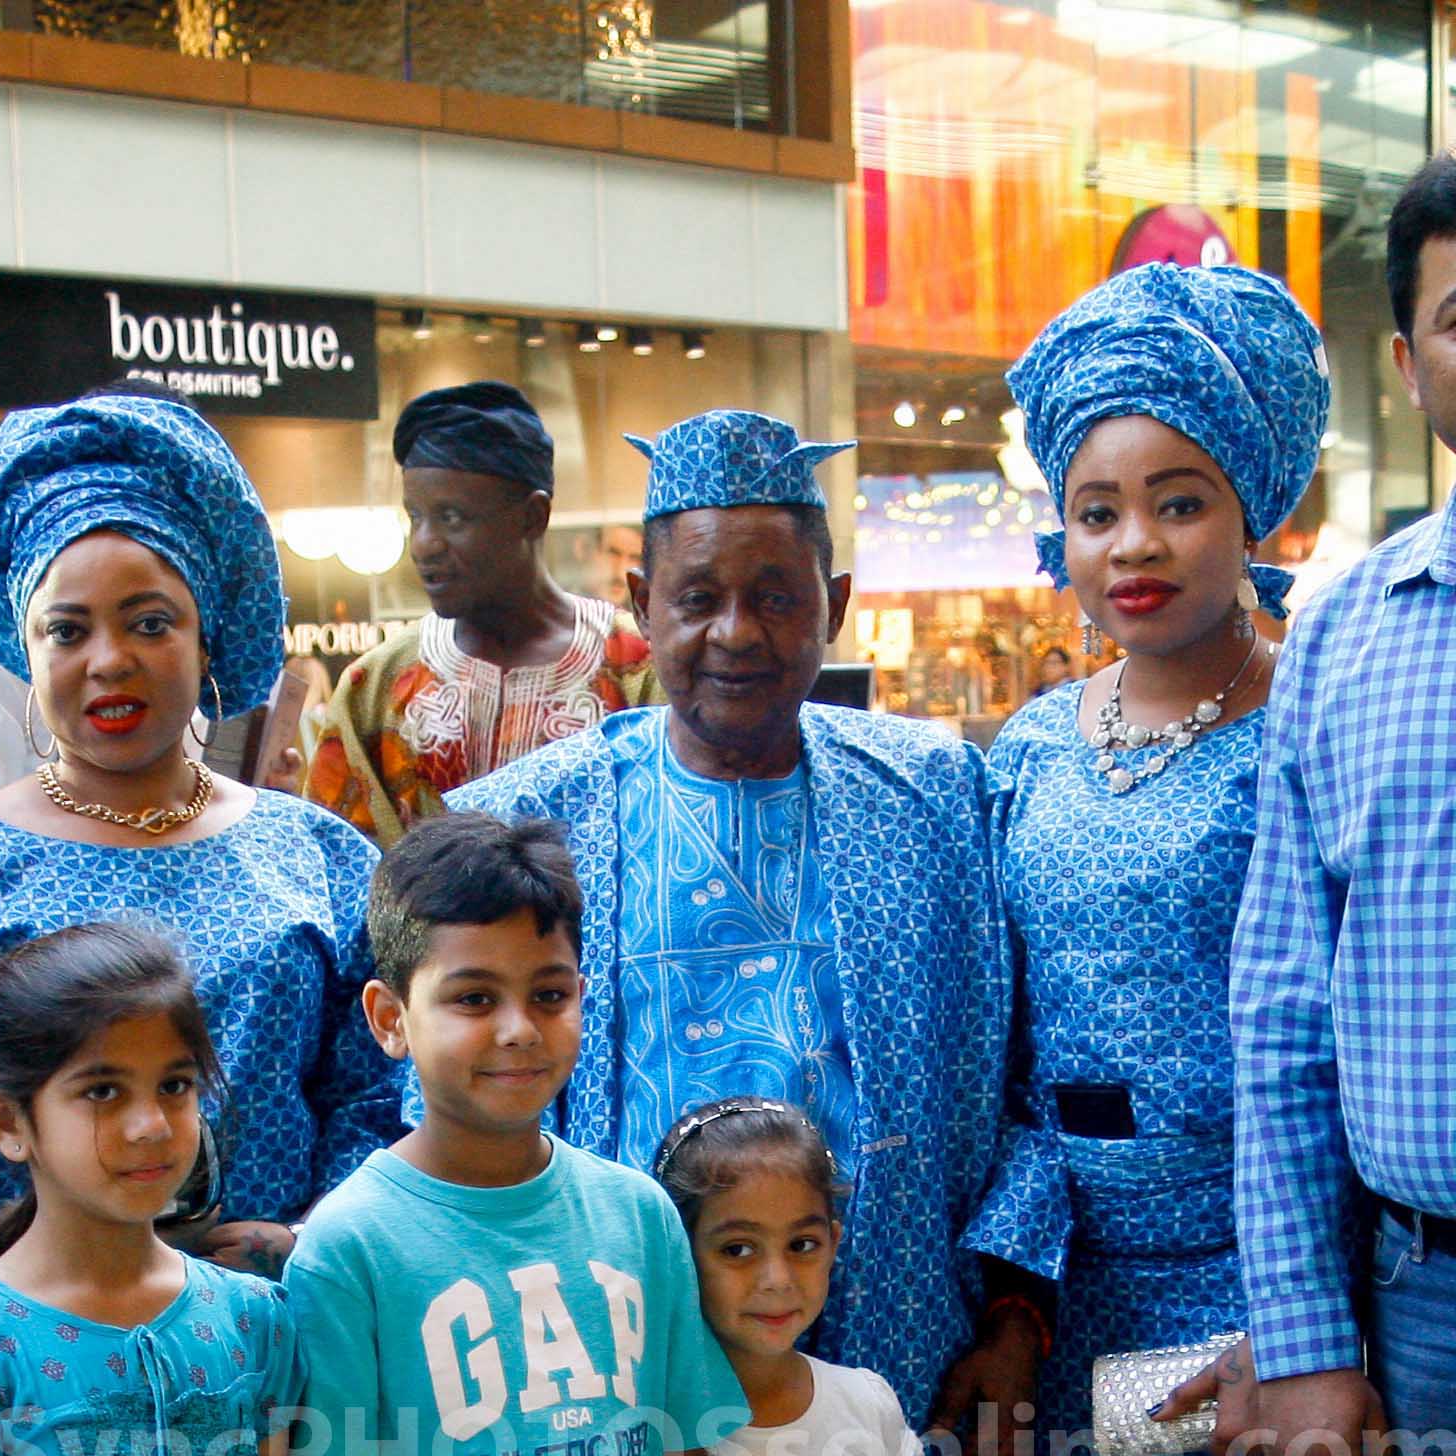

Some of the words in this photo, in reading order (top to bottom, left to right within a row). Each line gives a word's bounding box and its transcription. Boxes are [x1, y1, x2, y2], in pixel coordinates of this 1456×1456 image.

[104, 290, 355, 386] boutique.
[421, 1260, 647, 1442] GAP
[552, 1407, 592, 1431] USA
